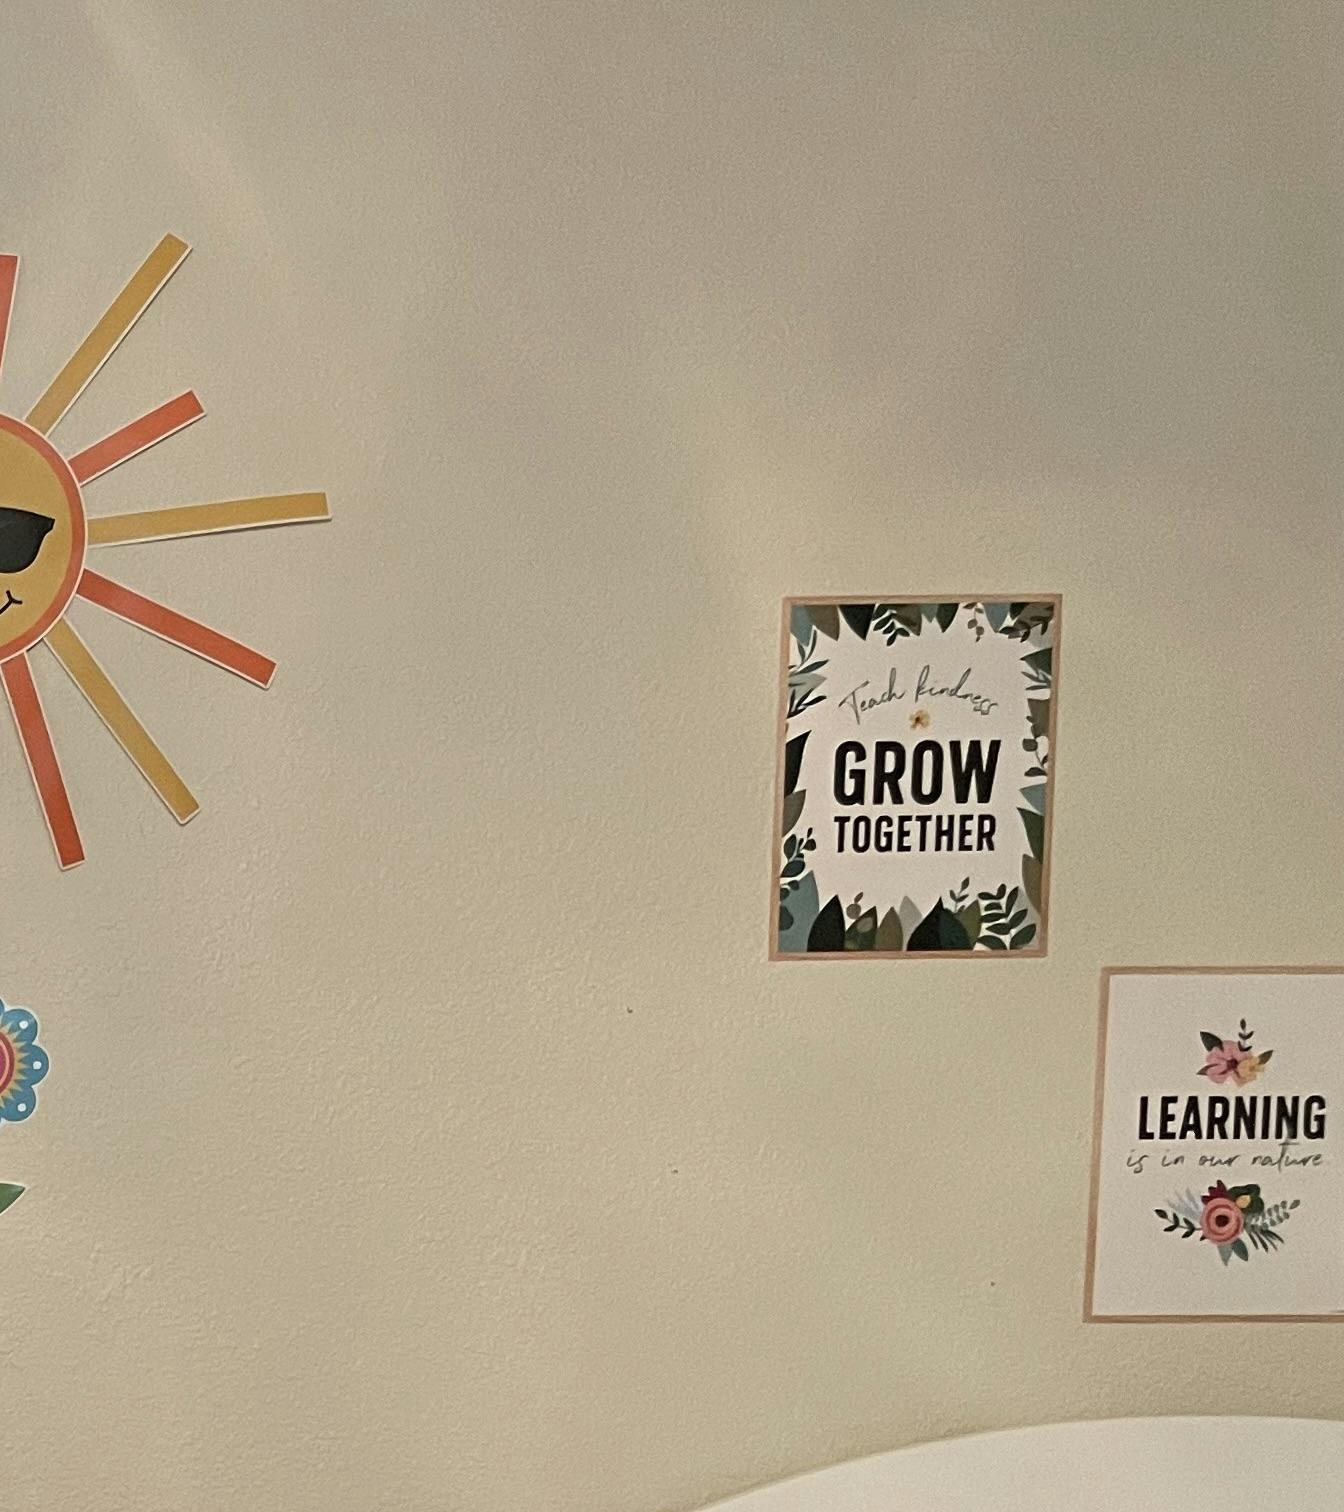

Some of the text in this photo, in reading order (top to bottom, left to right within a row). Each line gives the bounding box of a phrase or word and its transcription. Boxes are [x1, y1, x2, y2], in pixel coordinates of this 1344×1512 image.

[838, 667, 906, 725] Teach
[833, 739, 1002, 806] GROW
[833, 814, 996, 853] TOGETHER
[1138, 1095, 1326, 1140] LEARNING
[1126, 1139, 1323, 1174] is in our nature
